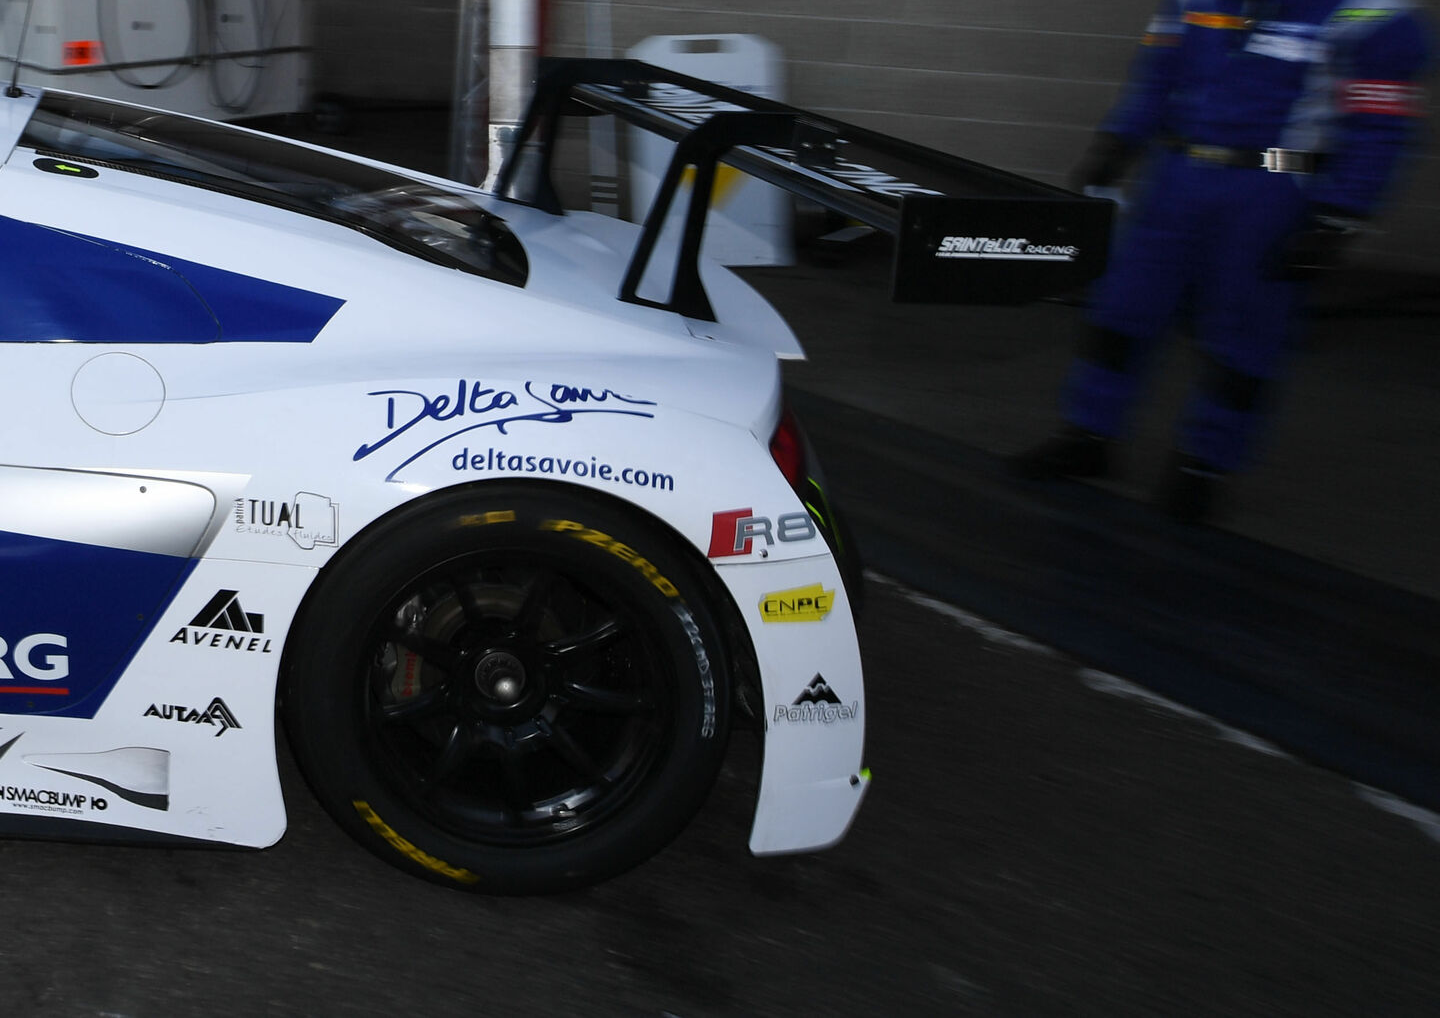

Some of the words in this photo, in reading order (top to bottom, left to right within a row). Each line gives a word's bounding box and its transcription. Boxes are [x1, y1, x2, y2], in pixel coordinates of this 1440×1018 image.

[1025, 245, 1080, 255] RACING
[353, 379, 518, 462] Delta
[451, 448, 675, 492] deltasavoie.com
[248, 499, 304, 529] TUAL
[733, 512, 816, 552] R8
[763, 595, 828, 614] CNPC
[169, 627, 272, 653] AVENEL
[773, 702, 858, 725] Patrigel
